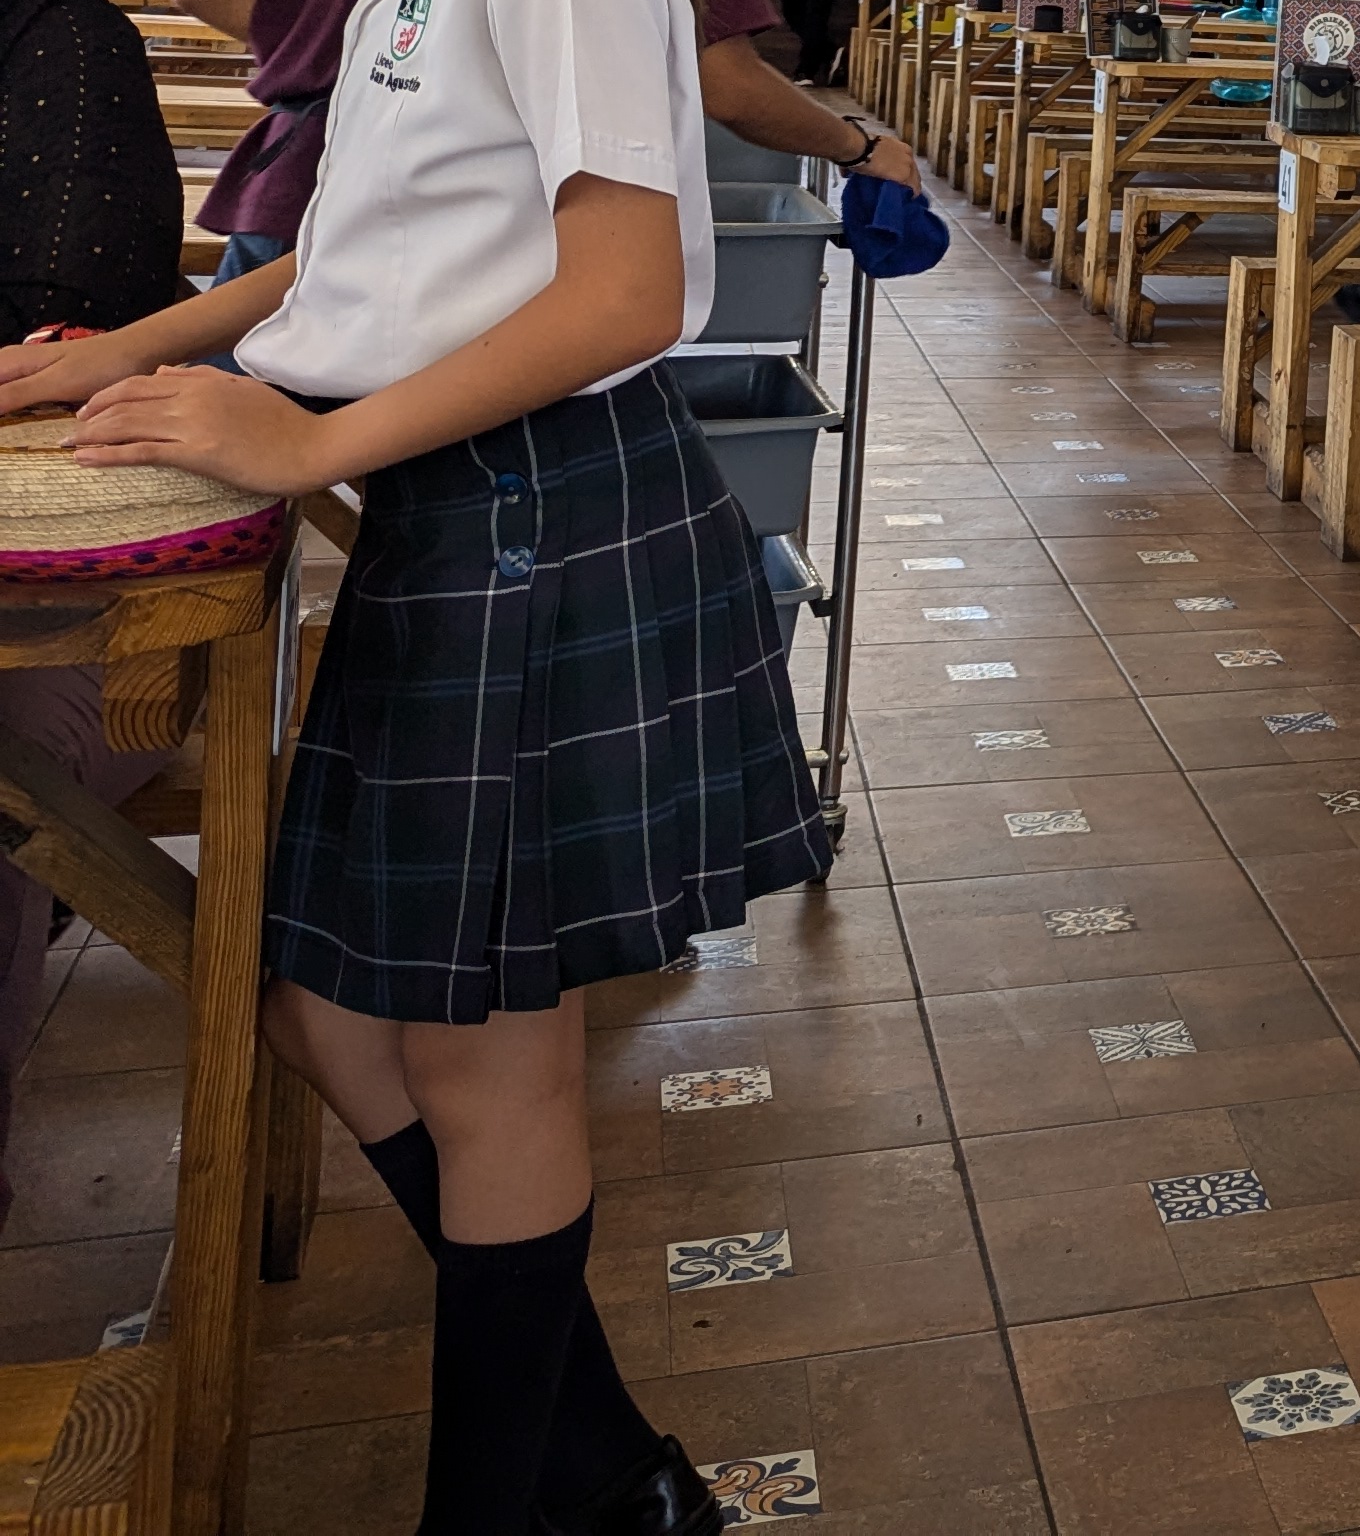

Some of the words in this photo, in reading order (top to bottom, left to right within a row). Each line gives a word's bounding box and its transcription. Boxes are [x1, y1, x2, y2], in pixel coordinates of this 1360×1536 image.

[374, 52, 394, 70] Liceo
[369, 67, 385, 86] San
[385, 72, 422, 94] Agustín
[1281, 164, 1292, 205] 41
